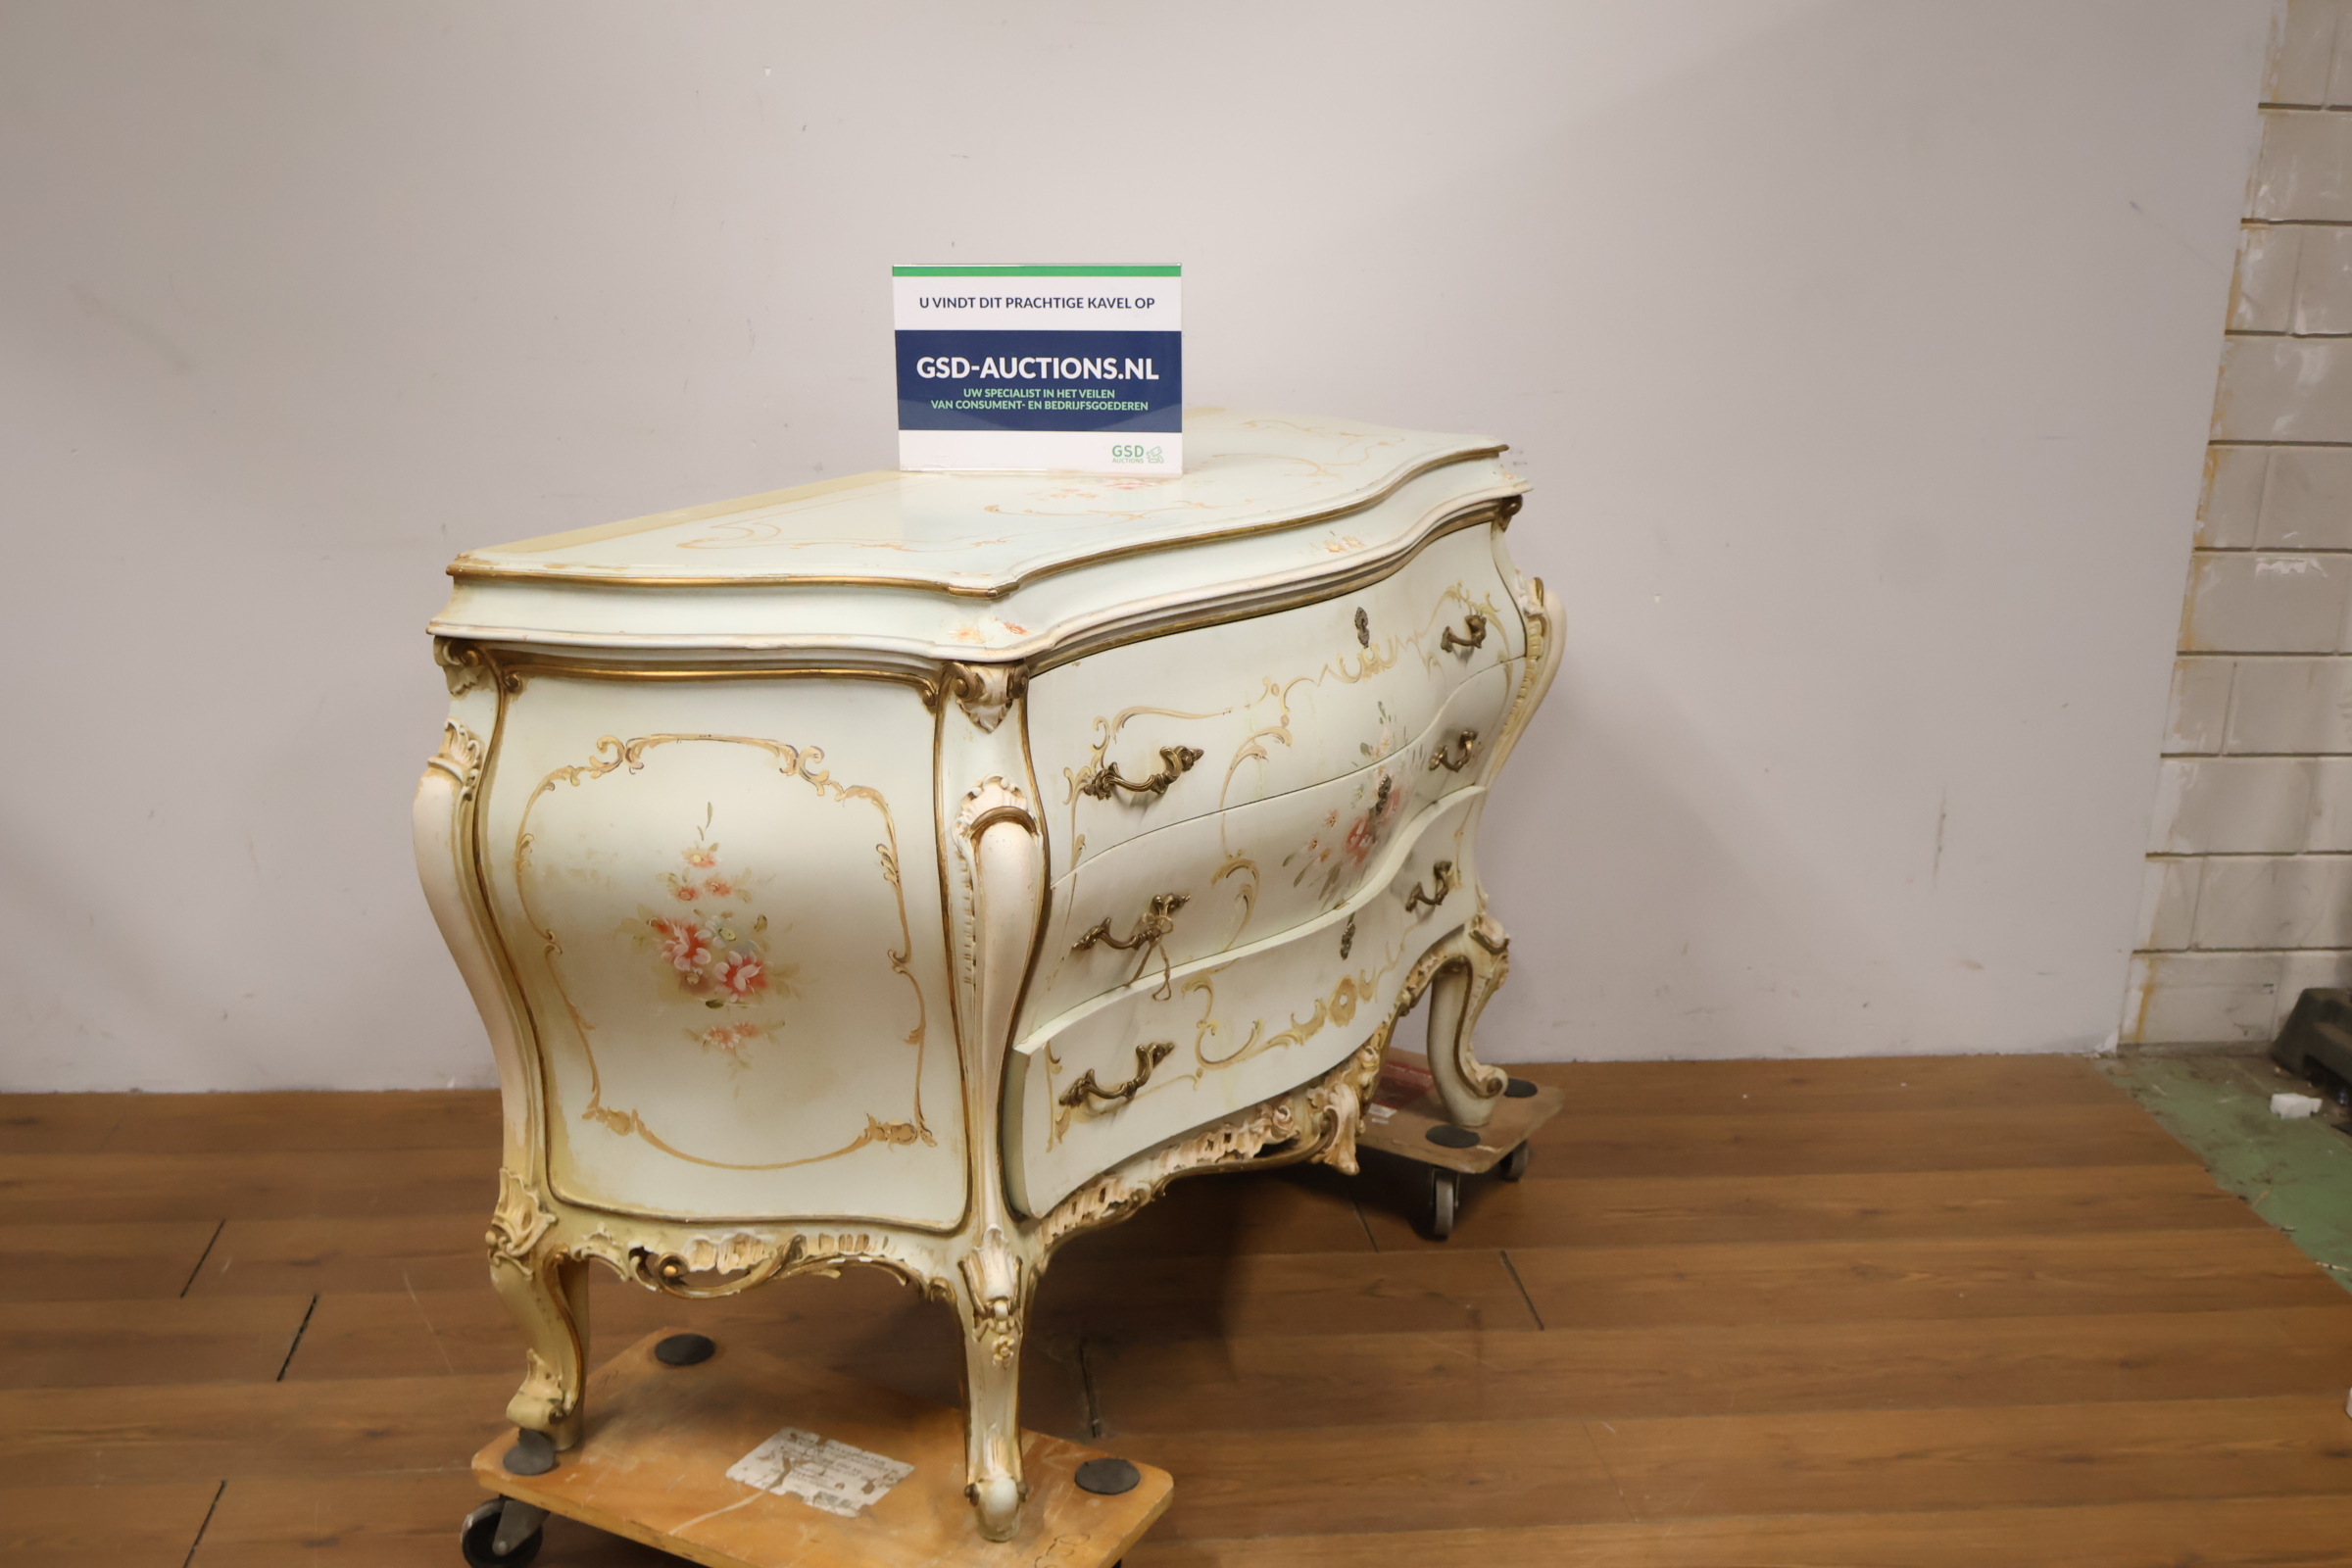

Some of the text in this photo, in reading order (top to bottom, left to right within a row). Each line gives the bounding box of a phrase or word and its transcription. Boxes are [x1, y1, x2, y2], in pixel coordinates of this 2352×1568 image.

[919, 297, 1155, 310] U VINDT DIT PRACHTIGE KAVEL OP
[916, 356, 1159, 380] GSD-AUCTIONS.NL
[963, 388, 1115, 399] UW SPECIALIST IN HET VEILEN
[931, 399, 1149, 411] VAN CONSUMENT- EN BEDRIJFSGOEDEREN
[1111, 444, 1145, 458] GSD
